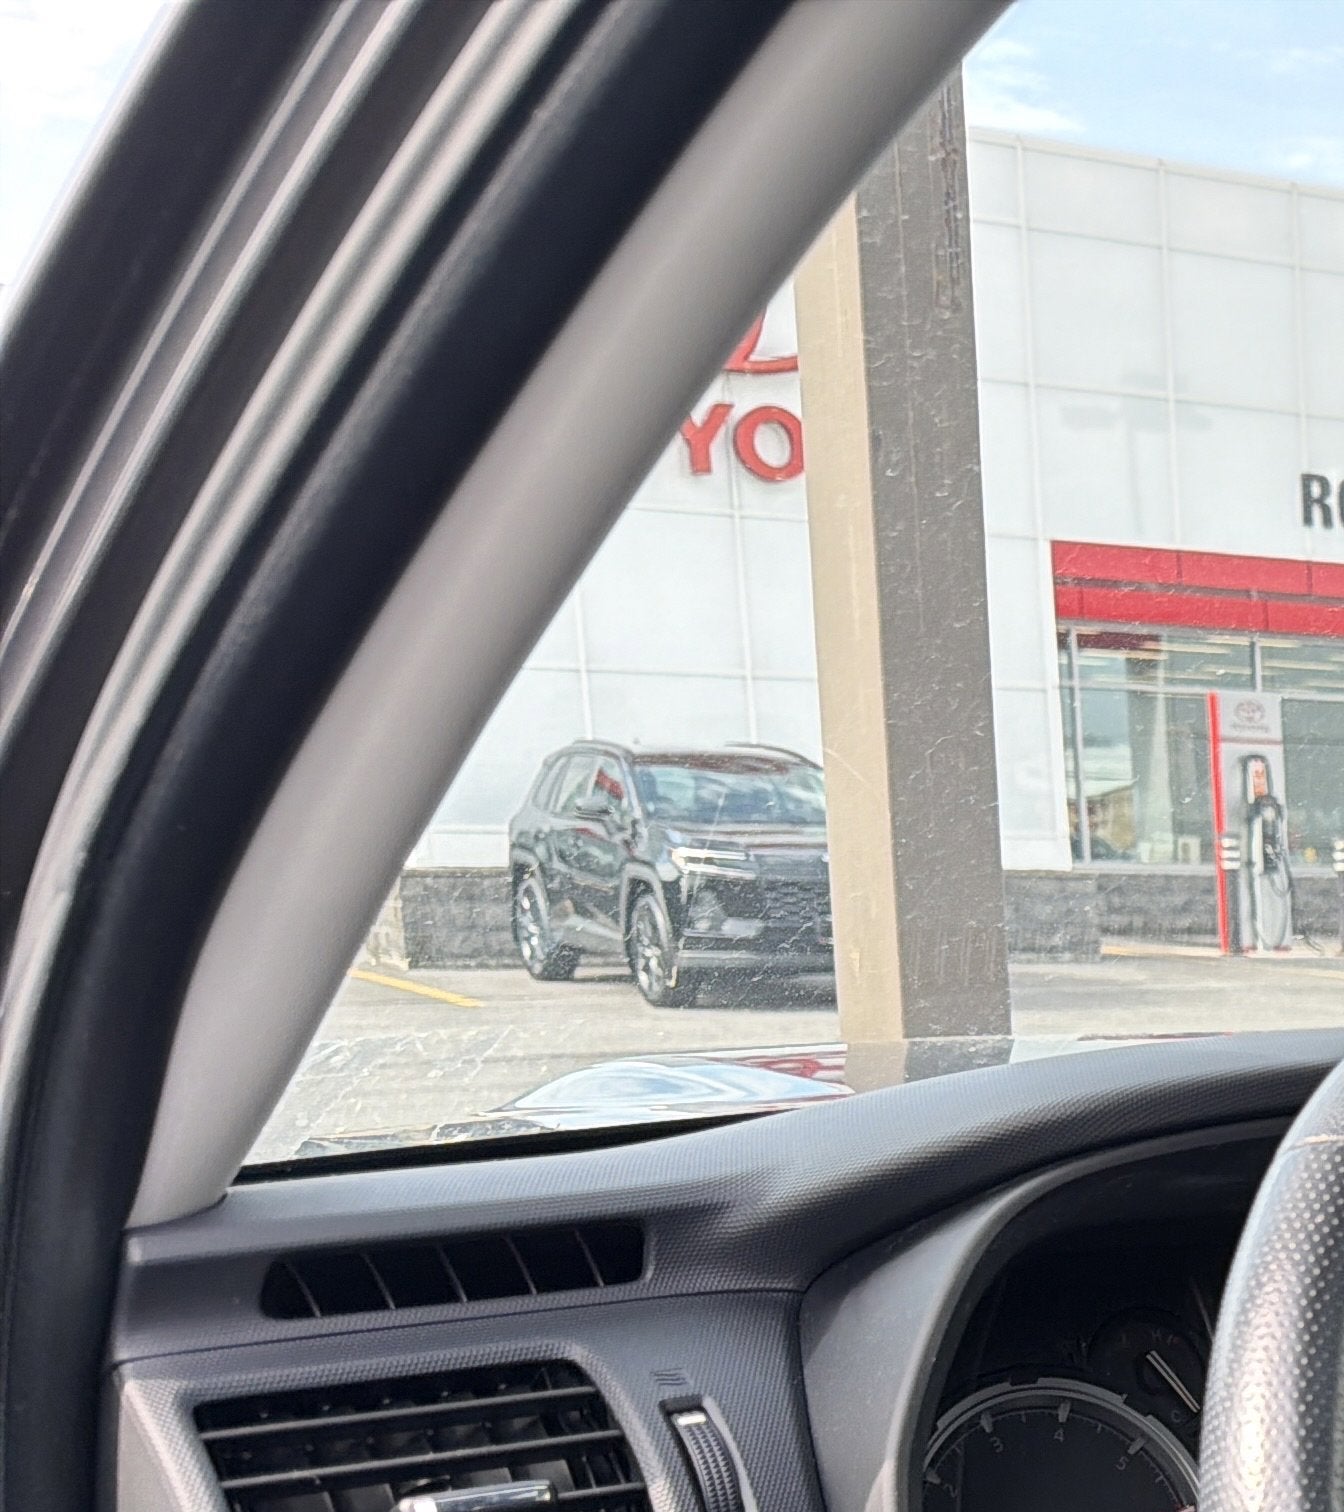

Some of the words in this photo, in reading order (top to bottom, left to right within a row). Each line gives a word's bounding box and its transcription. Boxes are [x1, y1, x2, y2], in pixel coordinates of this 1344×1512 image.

[989, 1436, 1004, 1453] 3
[1053, 1430, 1065, 1444] 4
[1115, 1455, 1129, 1472] 5
